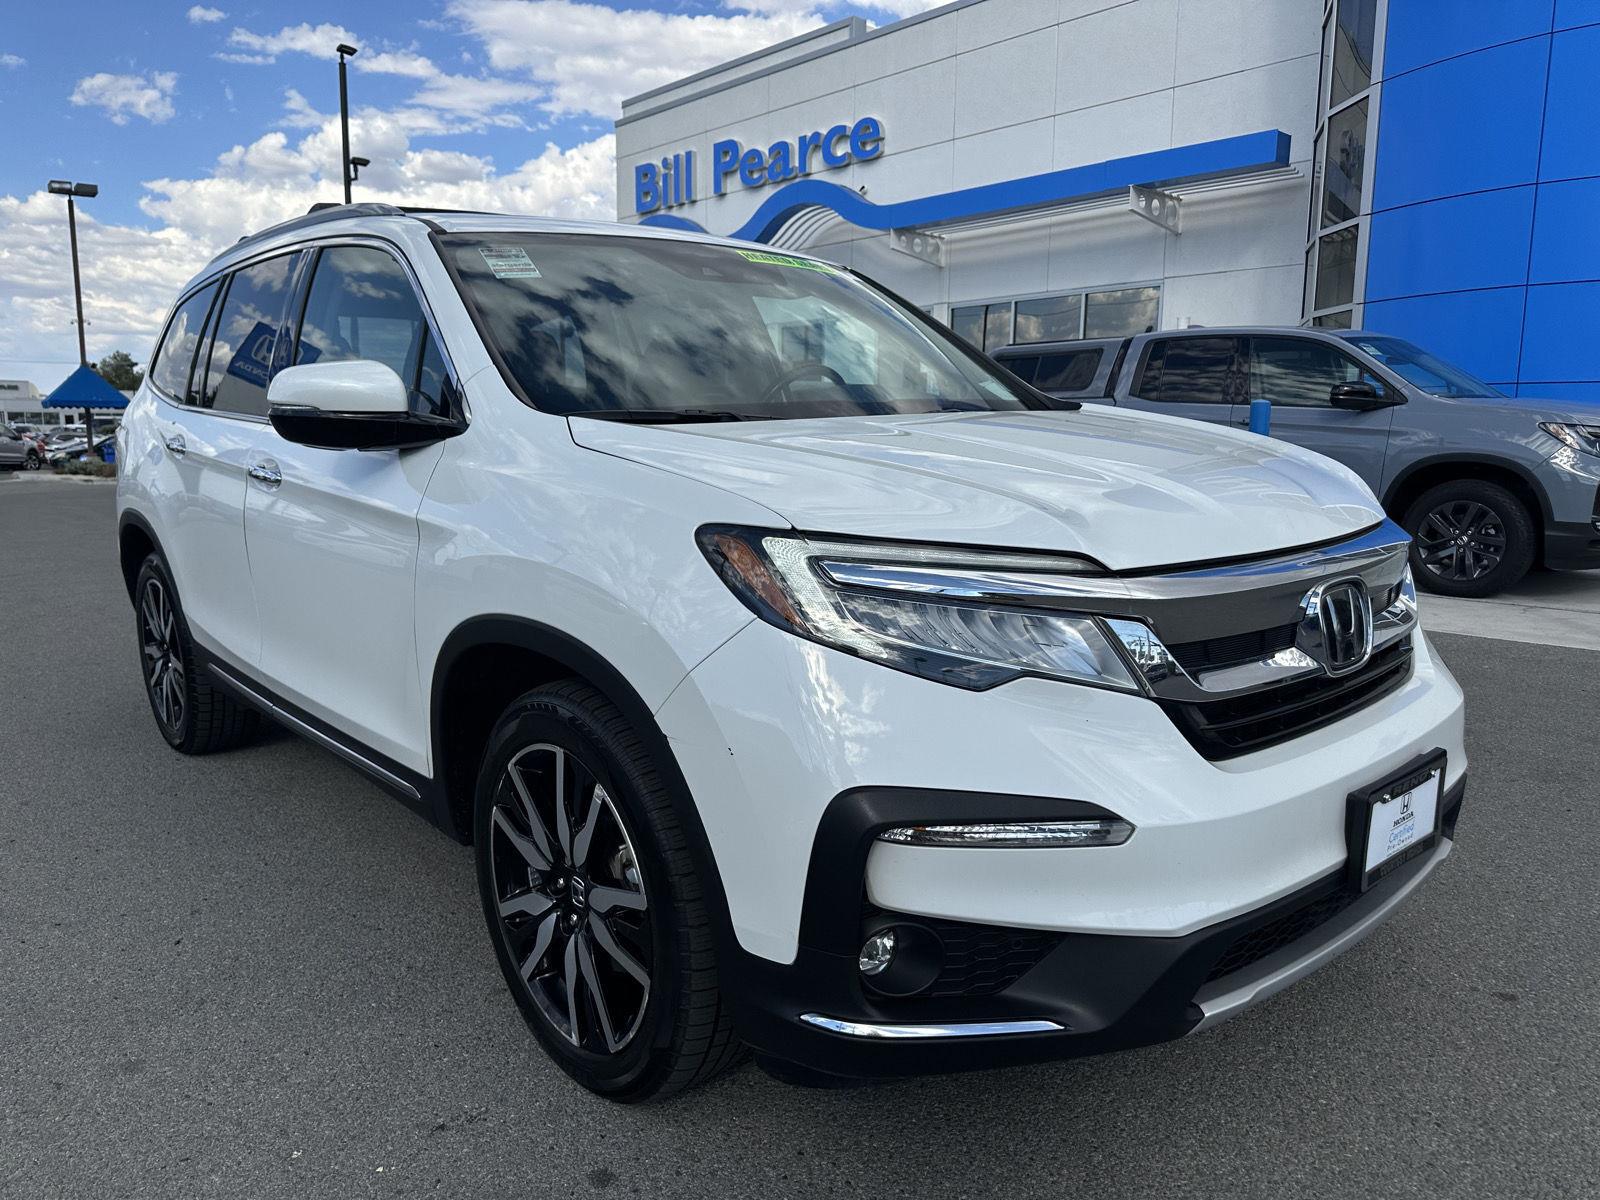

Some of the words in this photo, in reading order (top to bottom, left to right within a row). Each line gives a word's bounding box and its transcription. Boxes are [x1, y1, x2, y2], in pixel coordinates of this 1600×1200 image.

[634, 150, 697, 214] Bill
[713, 117, 884, 195] Pearce
[1393, 811, 1414, 828] HONDA
[1387, 833, 1414, 852] Pre-Owned
[1389, 822, 1415, 844] Certified
